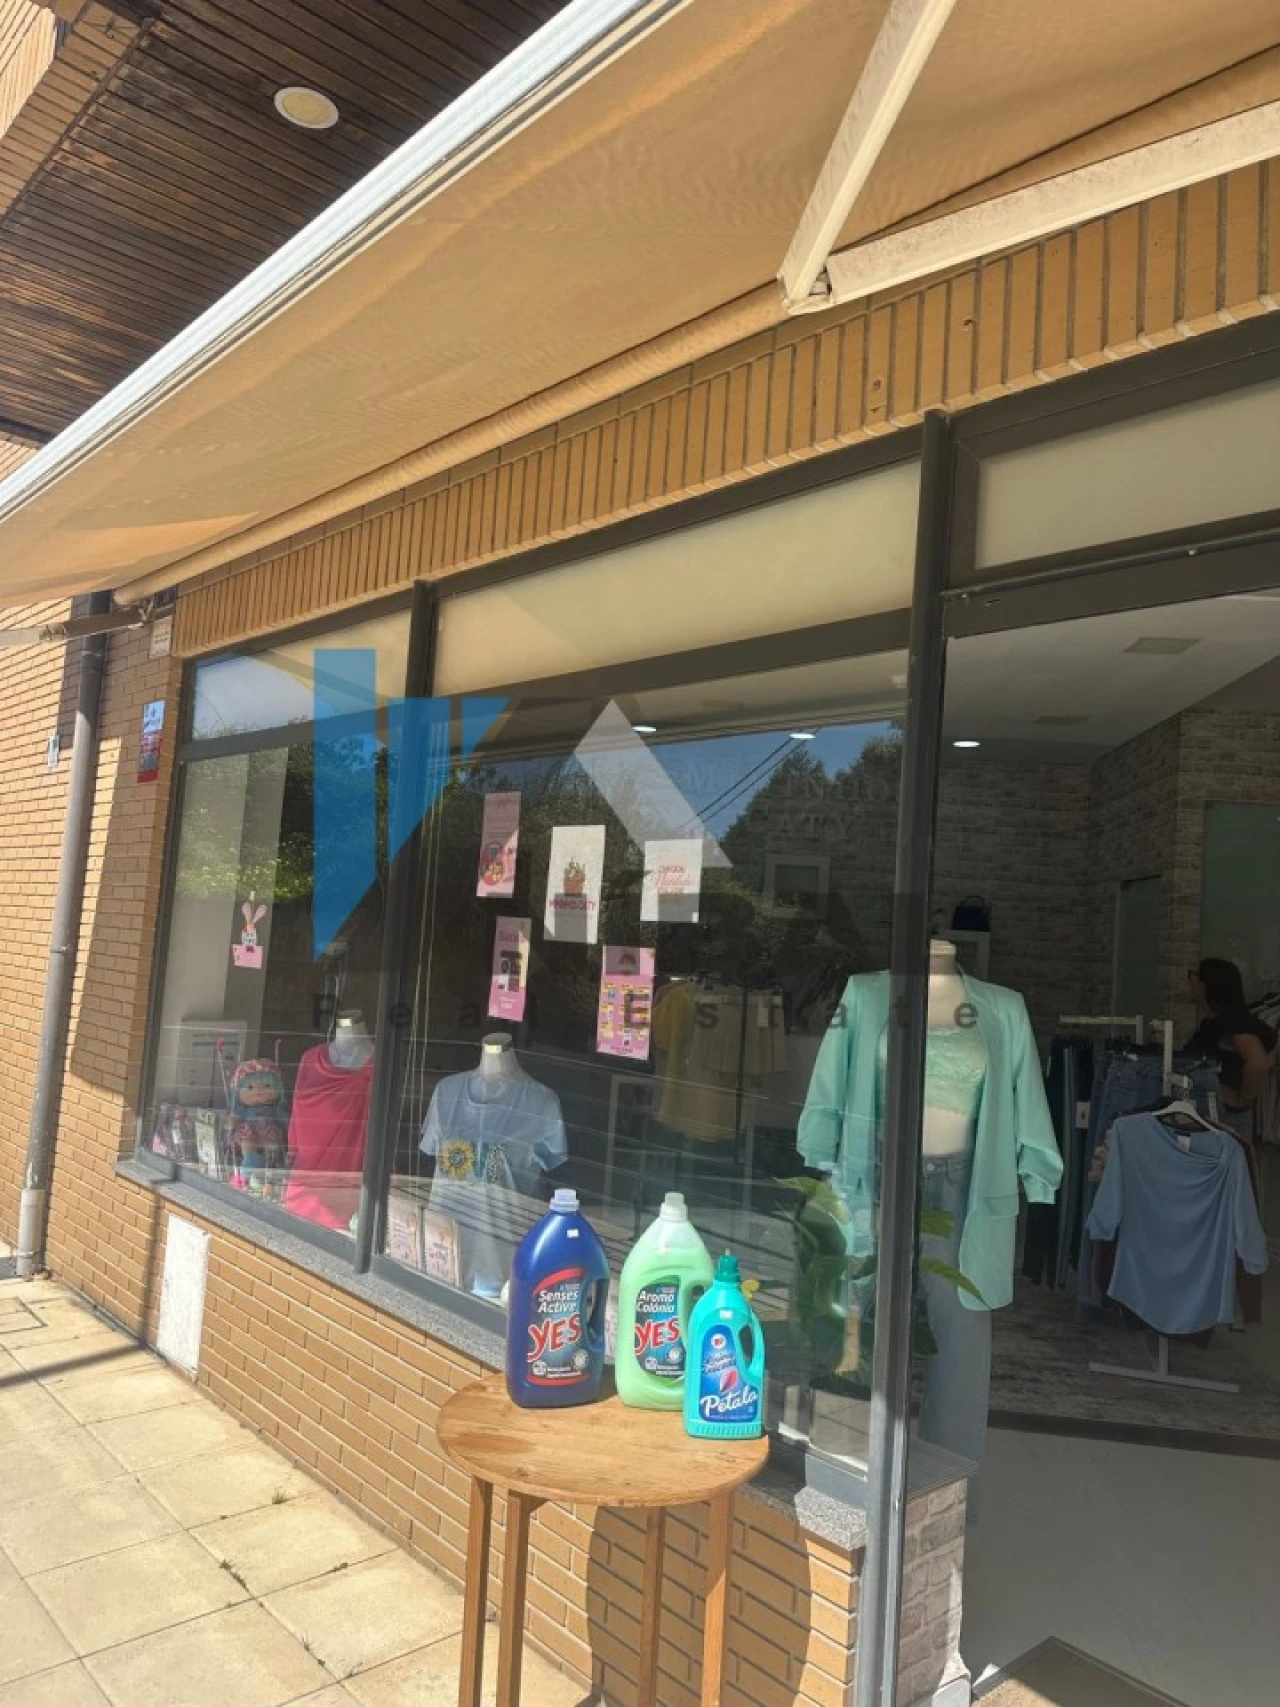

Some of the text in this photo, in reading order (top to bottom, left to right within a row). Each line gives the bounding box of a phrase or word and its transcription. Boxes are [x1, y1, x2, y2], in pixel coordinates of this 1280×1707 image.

[538, 1289, 579, 1303] Senses
[638, 1289, 675, 1302] Aroma
[537, 1301, 578, 1313] Active
[526, 1312, 582, 1363] YES
[634, 1316, 680, 1356] YES
